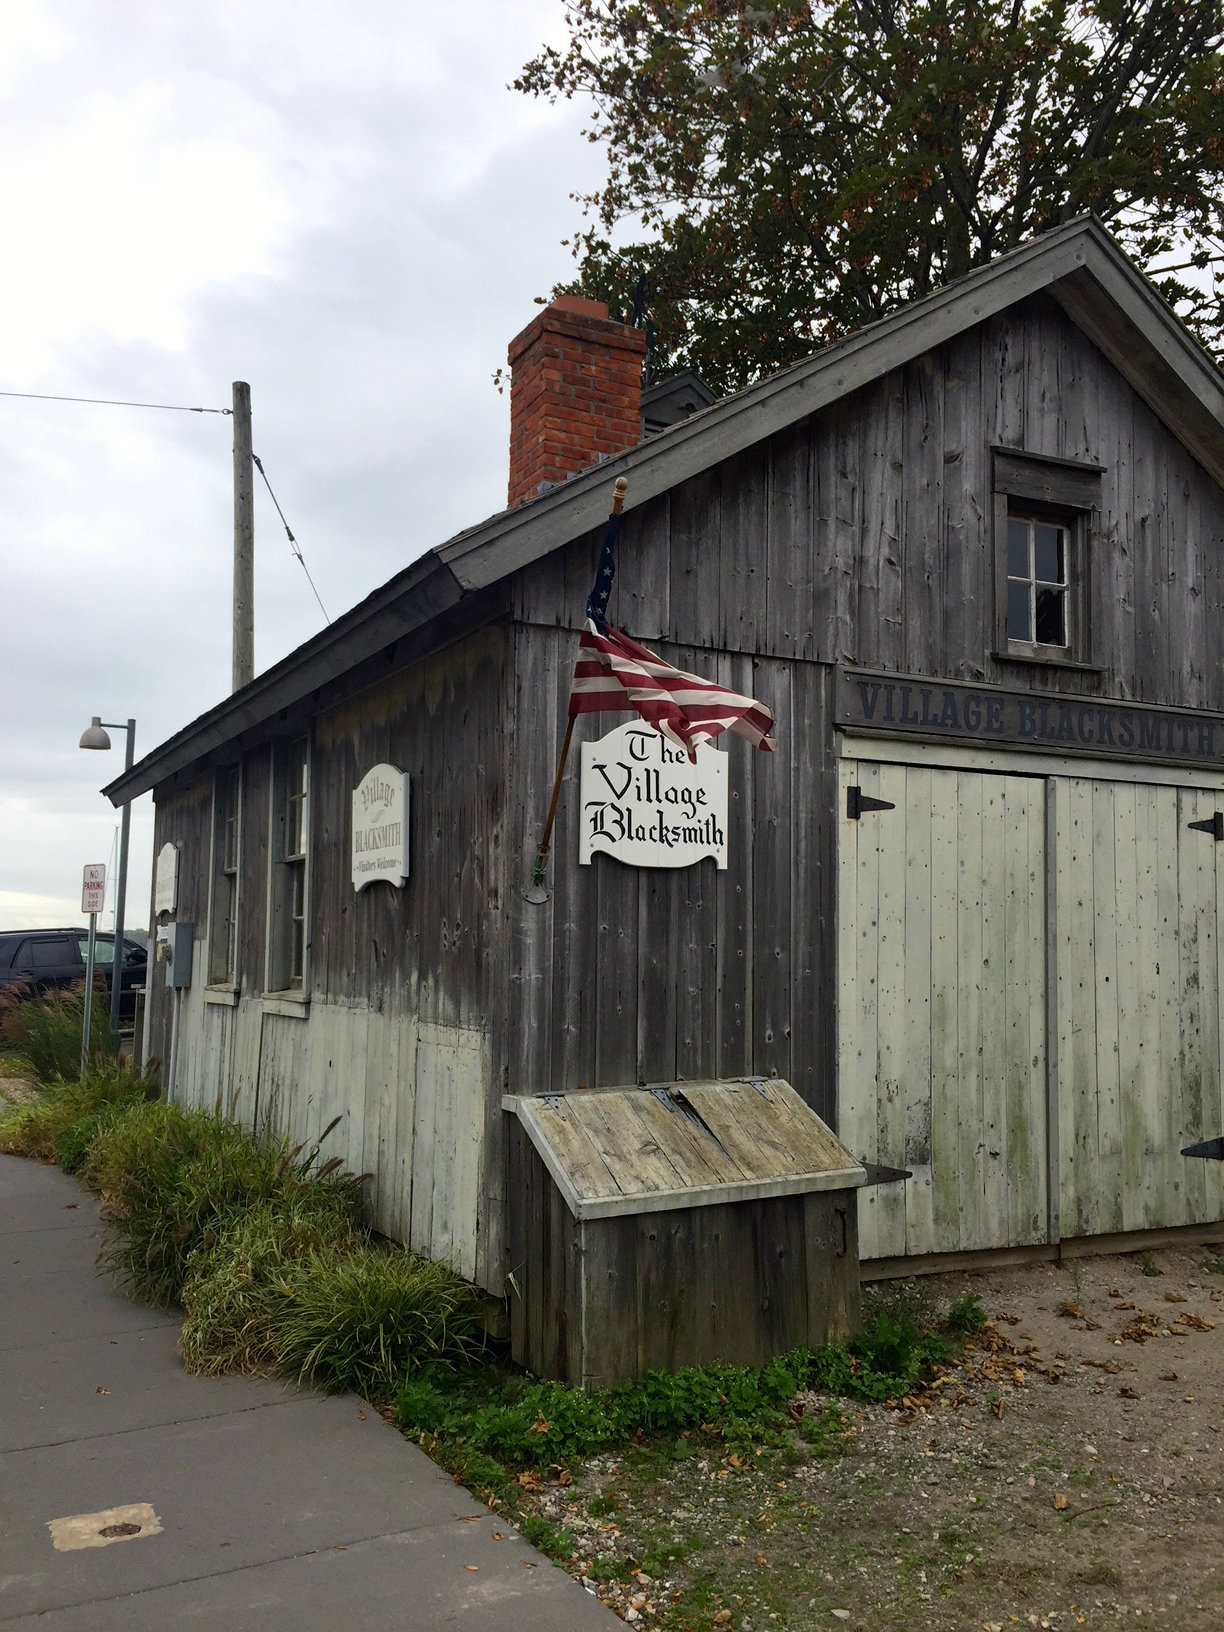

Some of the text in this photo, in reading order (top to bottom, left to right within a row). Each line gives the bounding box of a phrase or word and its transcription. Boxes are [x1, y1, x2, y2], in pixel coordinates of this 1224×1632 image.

[857, 681, 1217, 756] VILLAGE BLACKSMITH
[625, 730, 686, 764] The
[361, 776, 395, 811] Village
[591, 762, 708, 819] Village
[355, 822, 401, 853] BLACKSMITH
[585, 801, 724, 848] Blacksmith
[84, 881, 104, 891] PARKING
[89, 870, 98, 879] NO
[87, 900, 98, 908] SIDE
